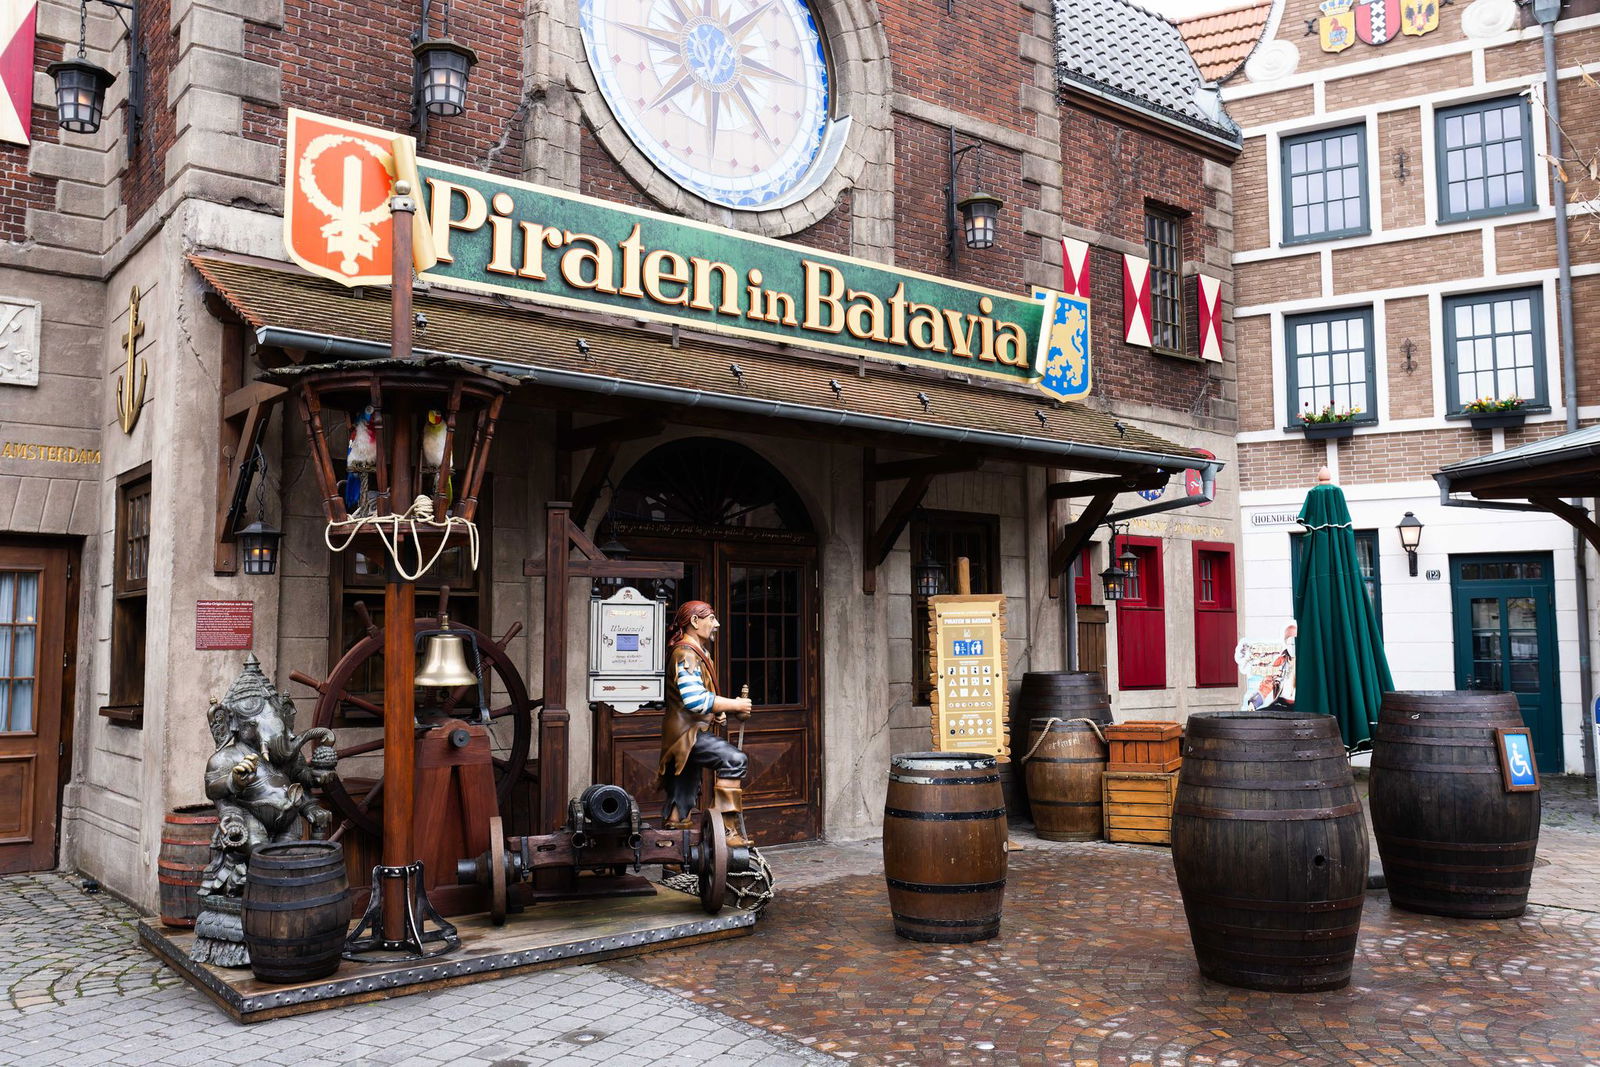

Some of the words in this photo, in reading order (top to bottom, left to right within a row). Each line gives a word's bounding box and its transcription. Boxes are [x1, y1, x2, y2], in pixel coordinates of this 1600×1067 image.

[425, 177, 742, 316] Piraten
[747, 268, 798, 327] in
[802, 259, 1029, 369] Batavia
[1, 441, 101, 464] AMSTERDAM
[610, 625, 645, 633] Wartezeit
